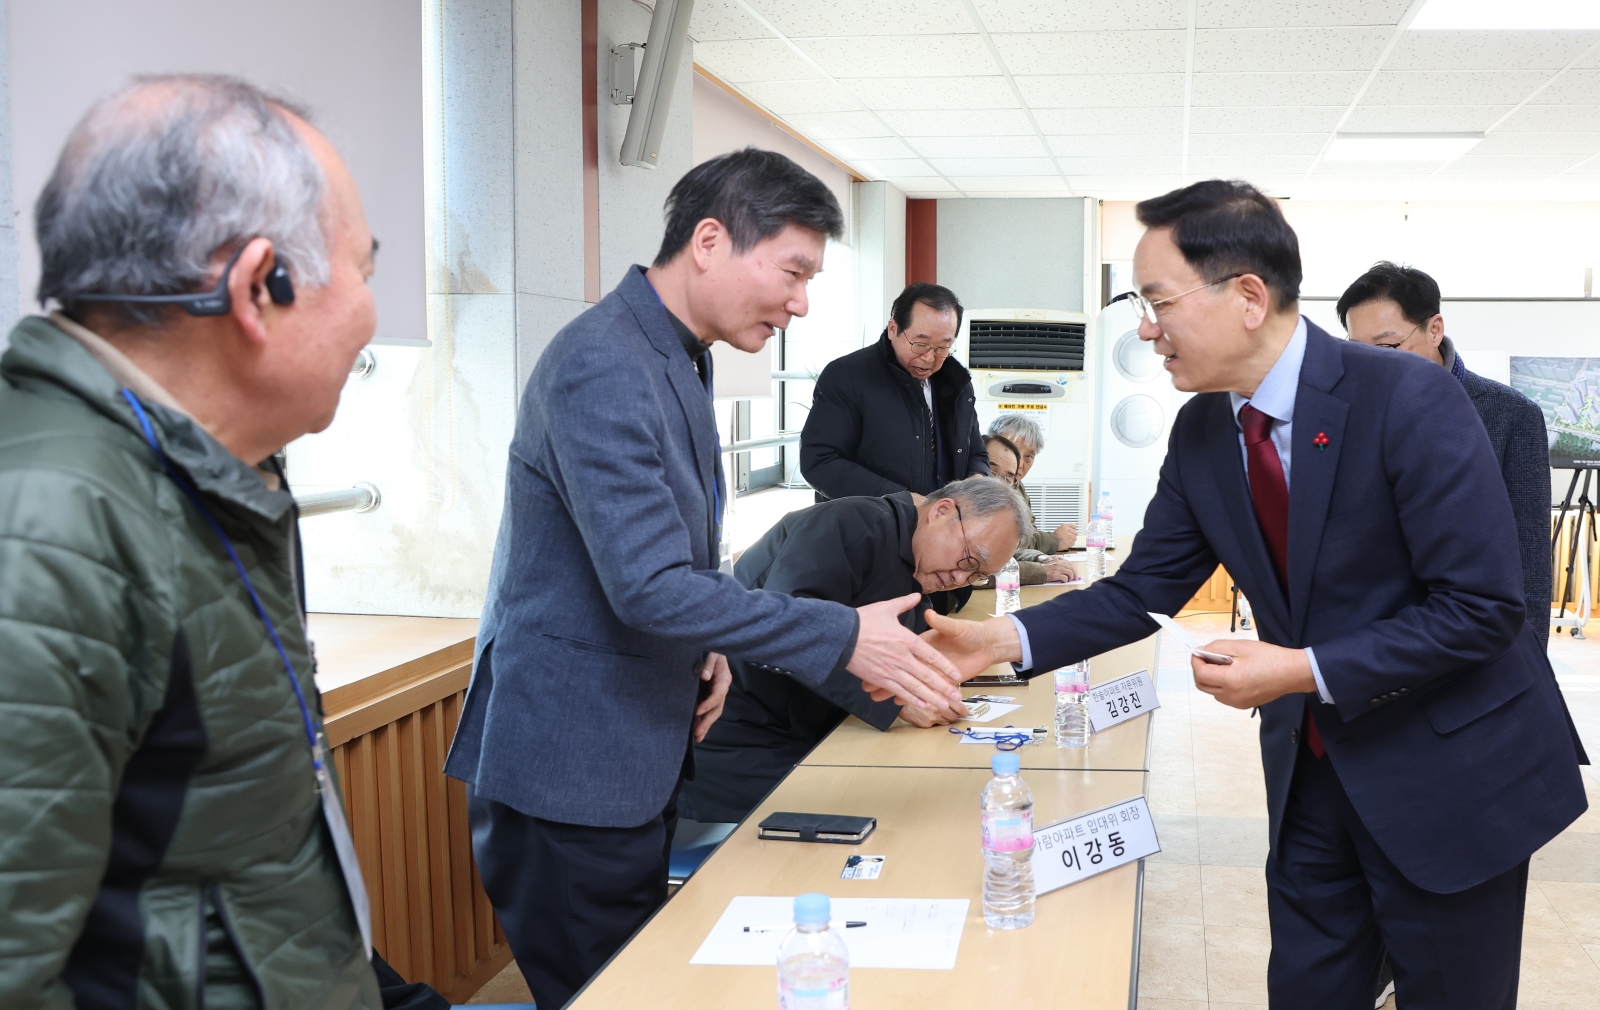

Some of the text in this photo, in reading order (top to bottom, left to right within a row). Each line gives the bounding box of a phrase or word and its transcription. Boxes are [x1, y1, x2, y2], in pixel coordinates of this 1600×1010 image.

[1092, 676, 1144, 703] 한솔아파트 자문위원
[1106, 691, 1142, 718] 김강진
[1087, 812, 1119, 834] 입대위
[1120, 805, 1140, 823] 회장
[1062, 831, 1125, 871] 이강동
